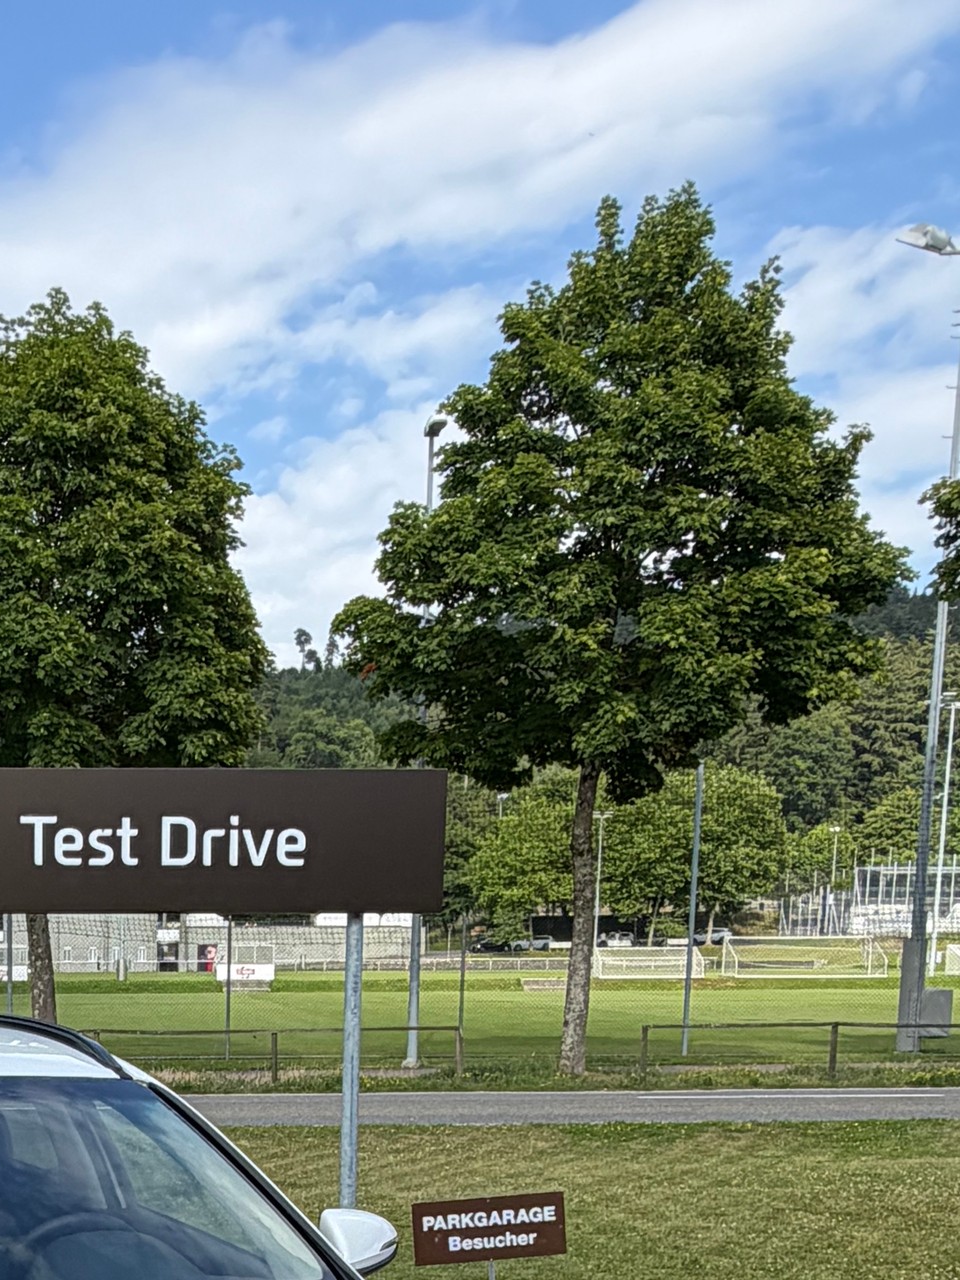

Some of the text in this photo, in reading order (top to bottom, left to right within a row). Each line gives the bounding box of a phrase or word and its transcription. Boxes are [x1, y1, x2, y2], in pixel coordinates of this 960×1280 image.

[19, 815, 307, 867] Test Drive
[421, 1205, 557, 1232] PARKGARAGE
[448, 1231, 538, 1252] Besucher
